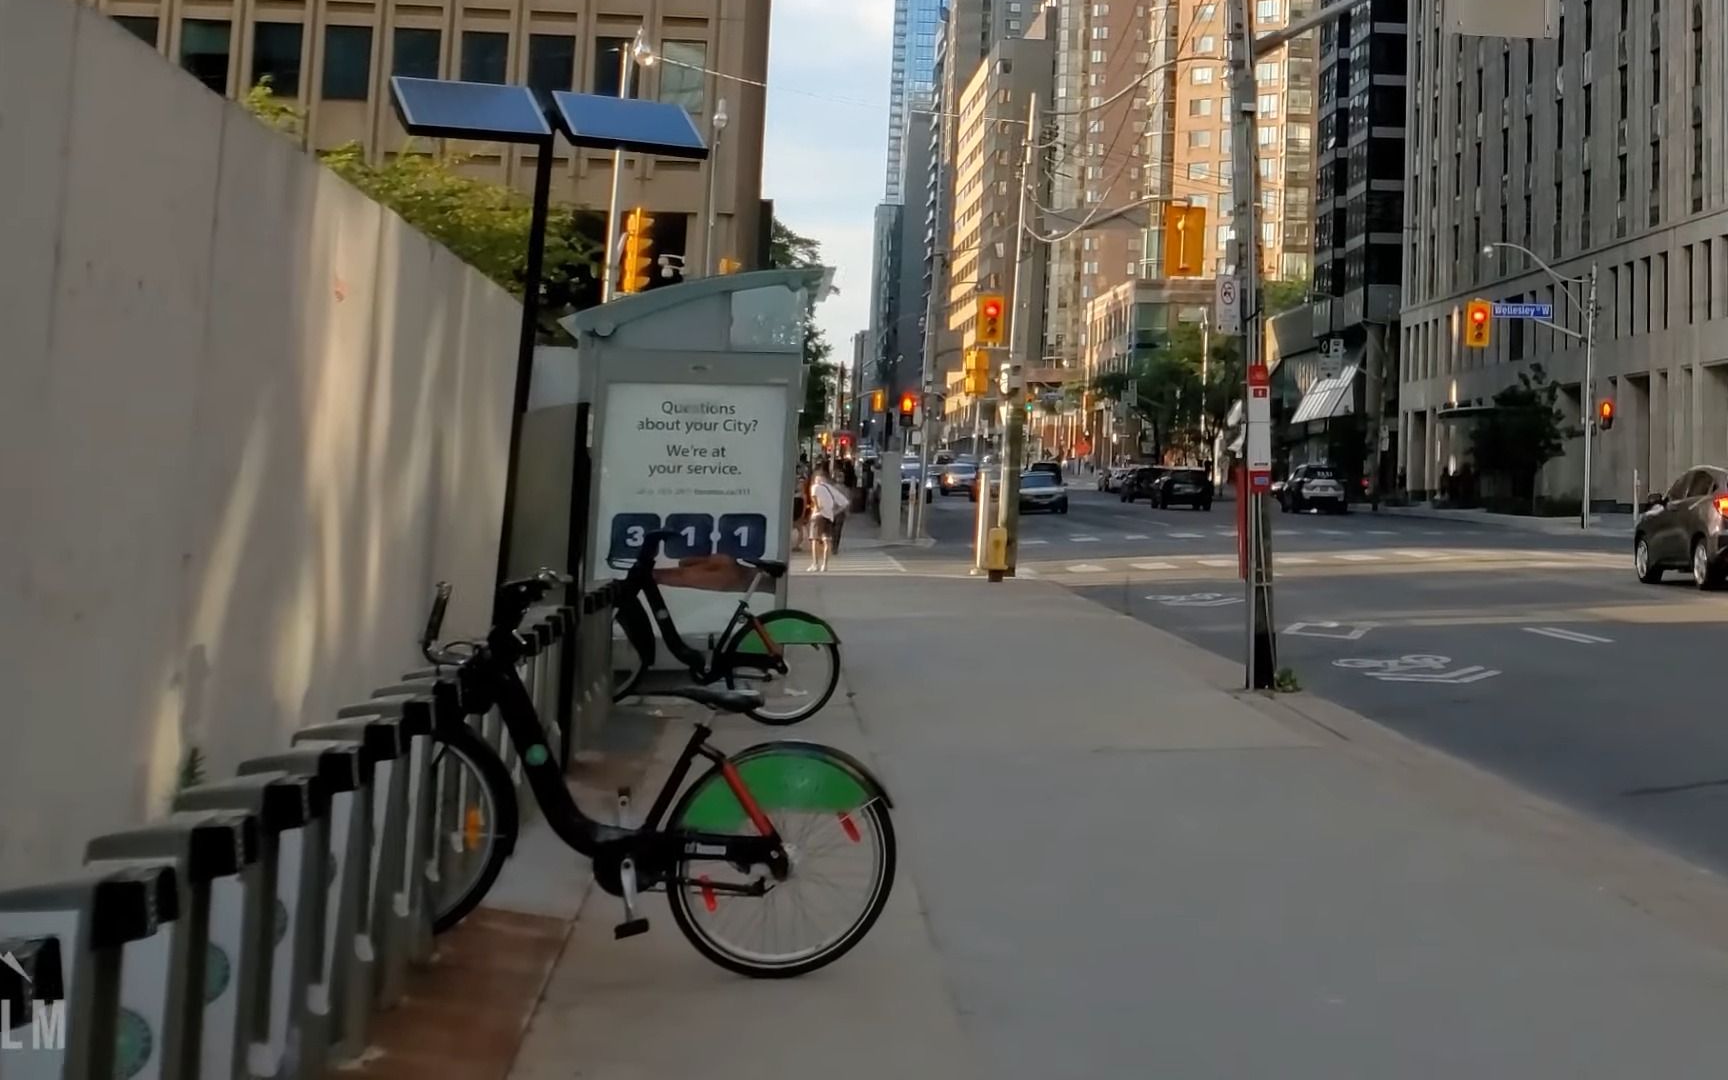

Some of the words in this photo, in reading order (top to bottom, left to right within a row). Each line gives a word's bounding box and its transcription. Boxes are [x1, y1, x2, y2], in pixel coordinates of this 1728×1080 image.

[1494, 304, 1536, 317] Wellesley
[661, 401, 736, 415] Quetions
[637, 417, 681, 431] about
[685, 421, 719, 435] your
[722, 419, 759, 435] City?
[666, 444, 708, 458] We're
[711, 446, 727, 458] at
[648, 464, 683, 477] your
[687, 462, 742, 475] service.
